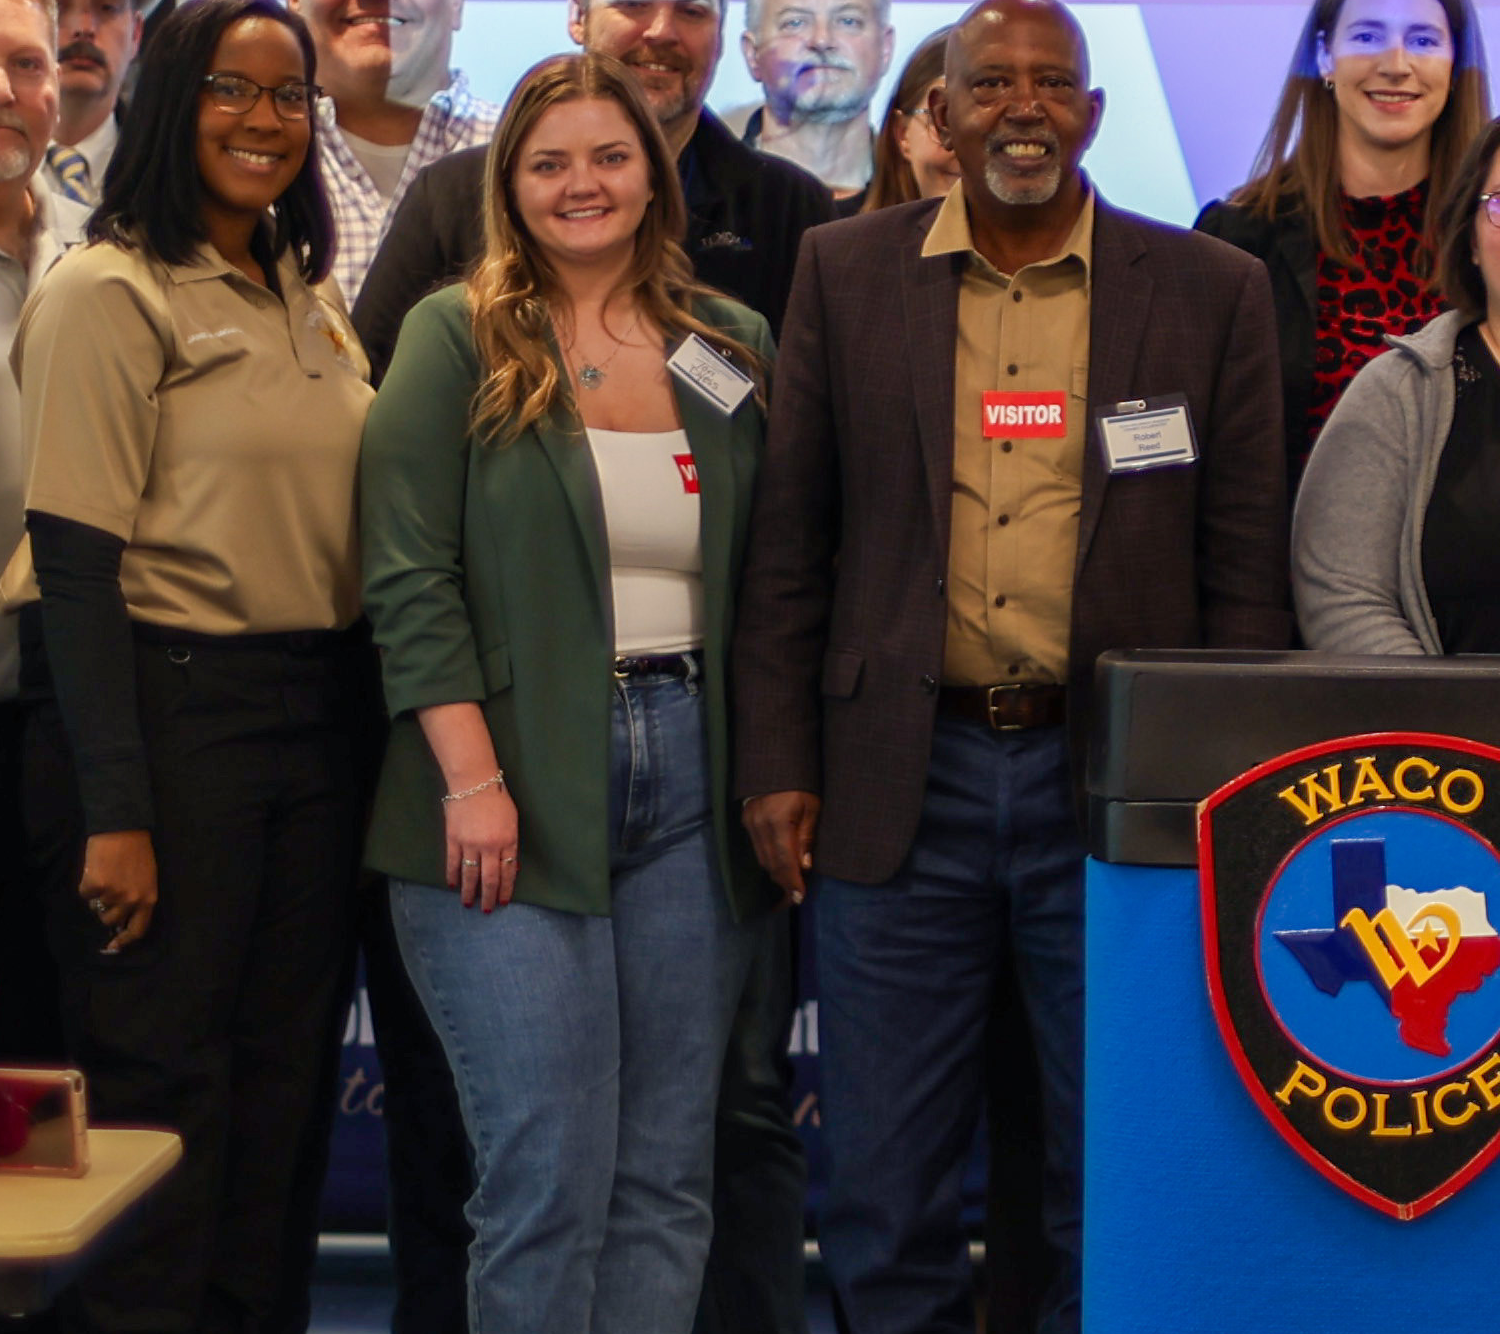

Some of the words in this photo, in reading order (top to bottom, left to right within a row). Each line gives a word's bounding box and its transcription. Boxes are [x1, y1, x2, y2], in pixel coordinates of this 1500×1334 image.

[985, 404, 1063, 425] VISITOR
[1133, 430, 1163, 442] Robert
[1138, 441, 1161, 452] Reed
[1278, 755, 1485, 827] WACO
